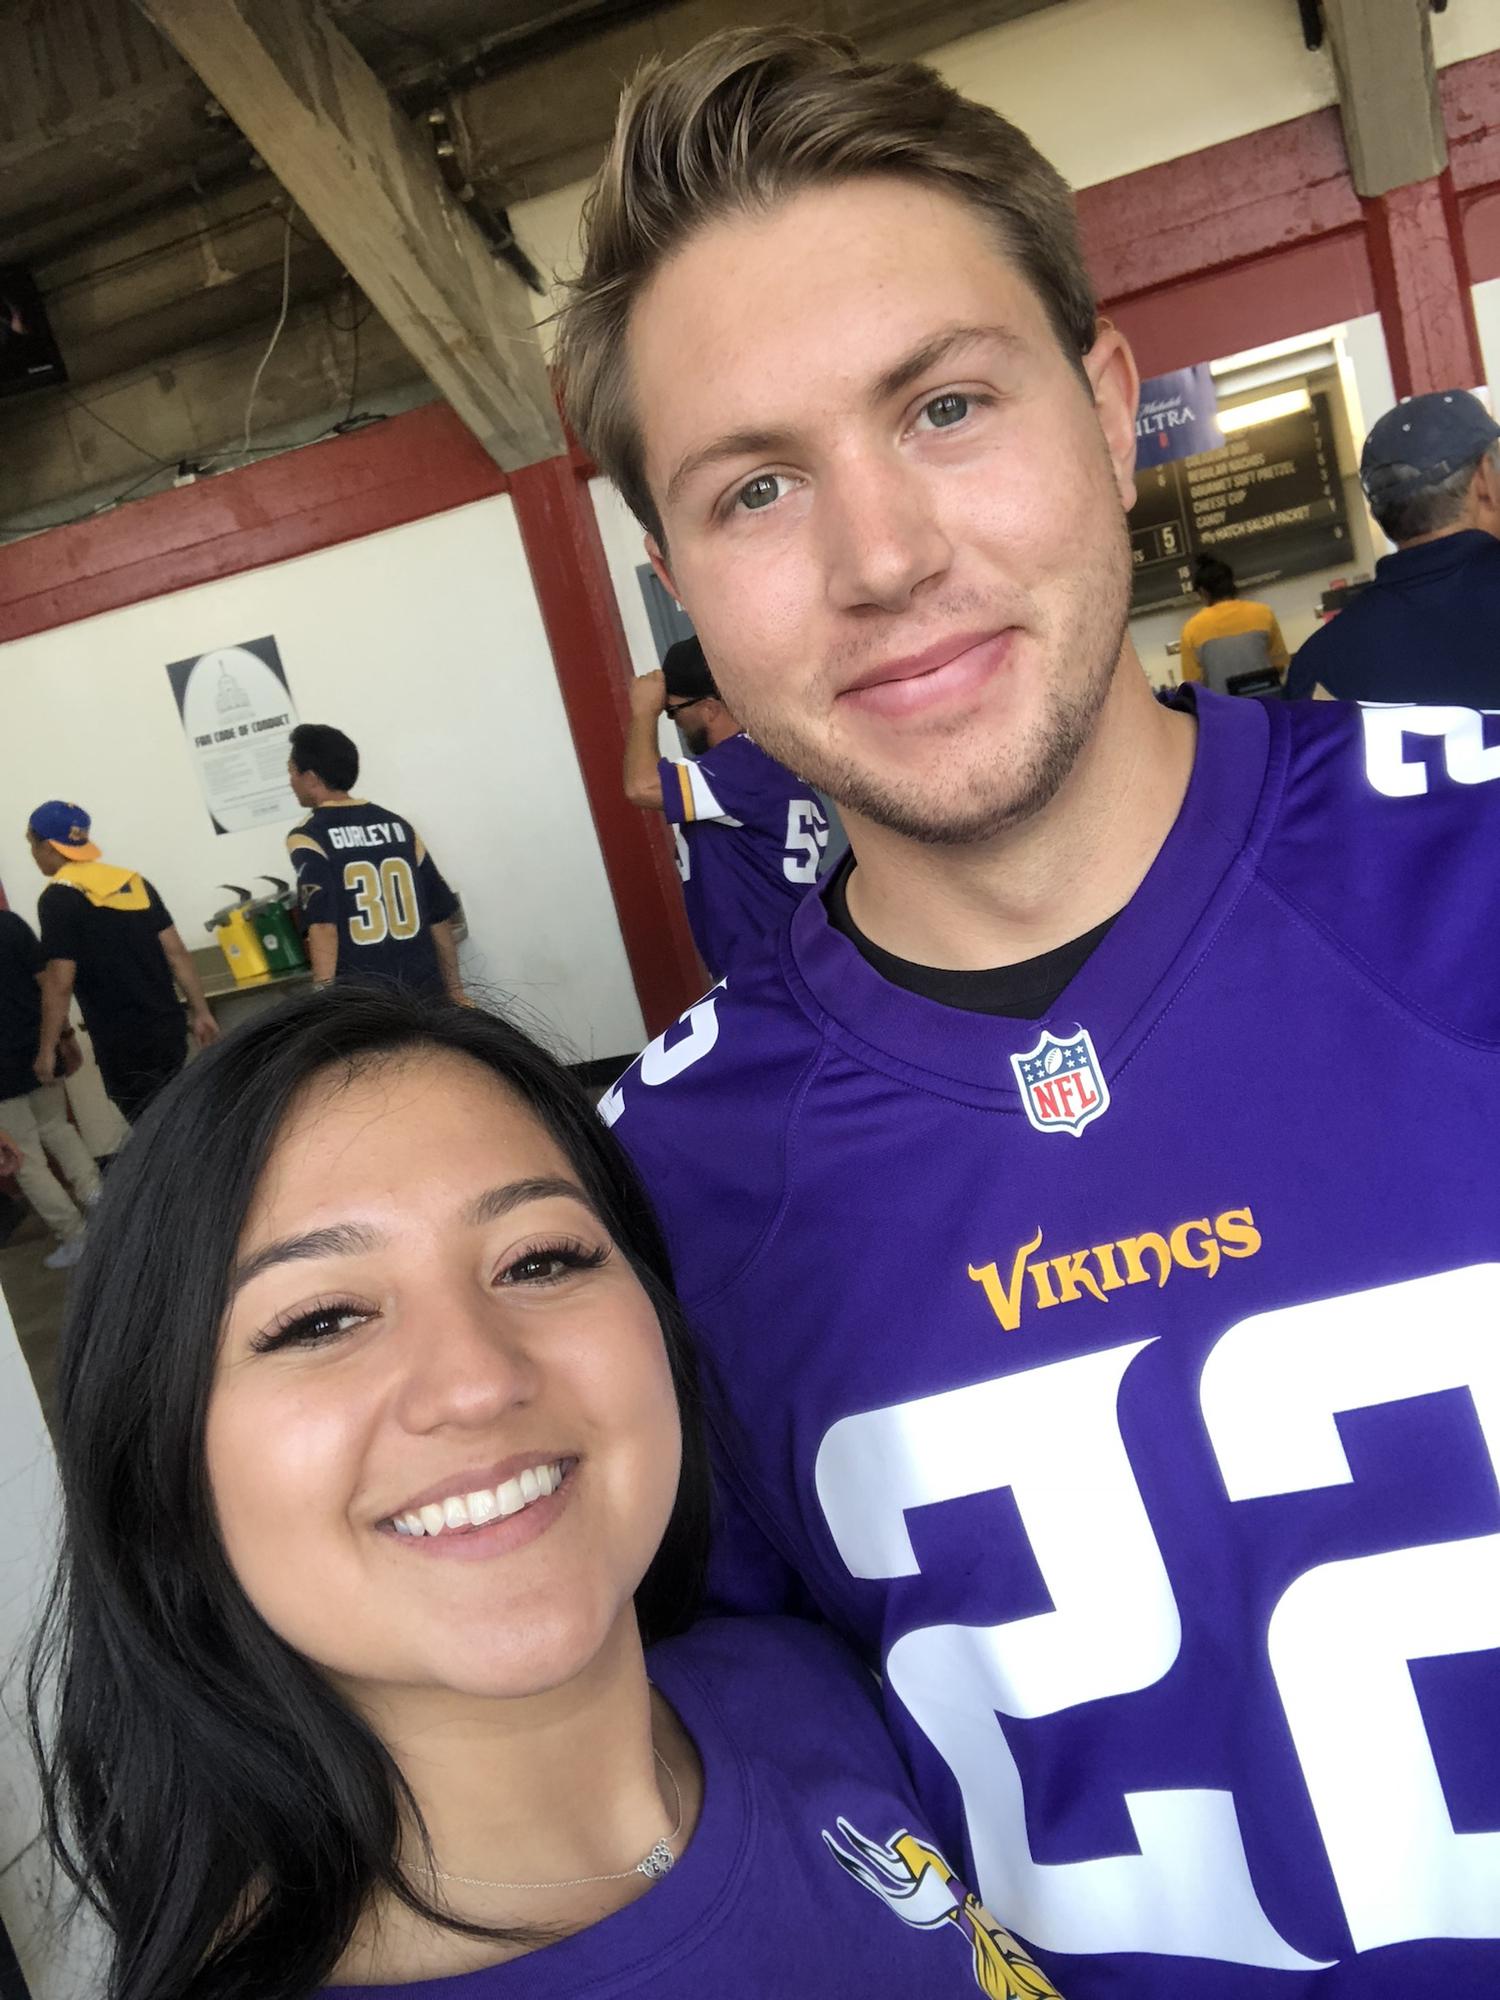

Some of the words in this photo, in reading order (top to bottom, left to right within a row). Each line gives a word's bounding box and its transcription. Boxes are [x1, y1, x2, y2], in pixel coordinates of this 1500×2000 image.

[1193, 494, 1227, 514] CHEESE
[1227, 489, 1248, 505] CUP
[1162, 526, 1175, 548] 5
[214, 728, 236, 743] CODE
[238, 724, 249, 737] OF
[251, 713, 290, 733] CONDUCT
[327, 822, 393, 849] GURLEY
[344, 857, 420, 945] 30
[1033, 1071, 1097, 1119] NFL
[815, 1262, 1500, 1970] 22
